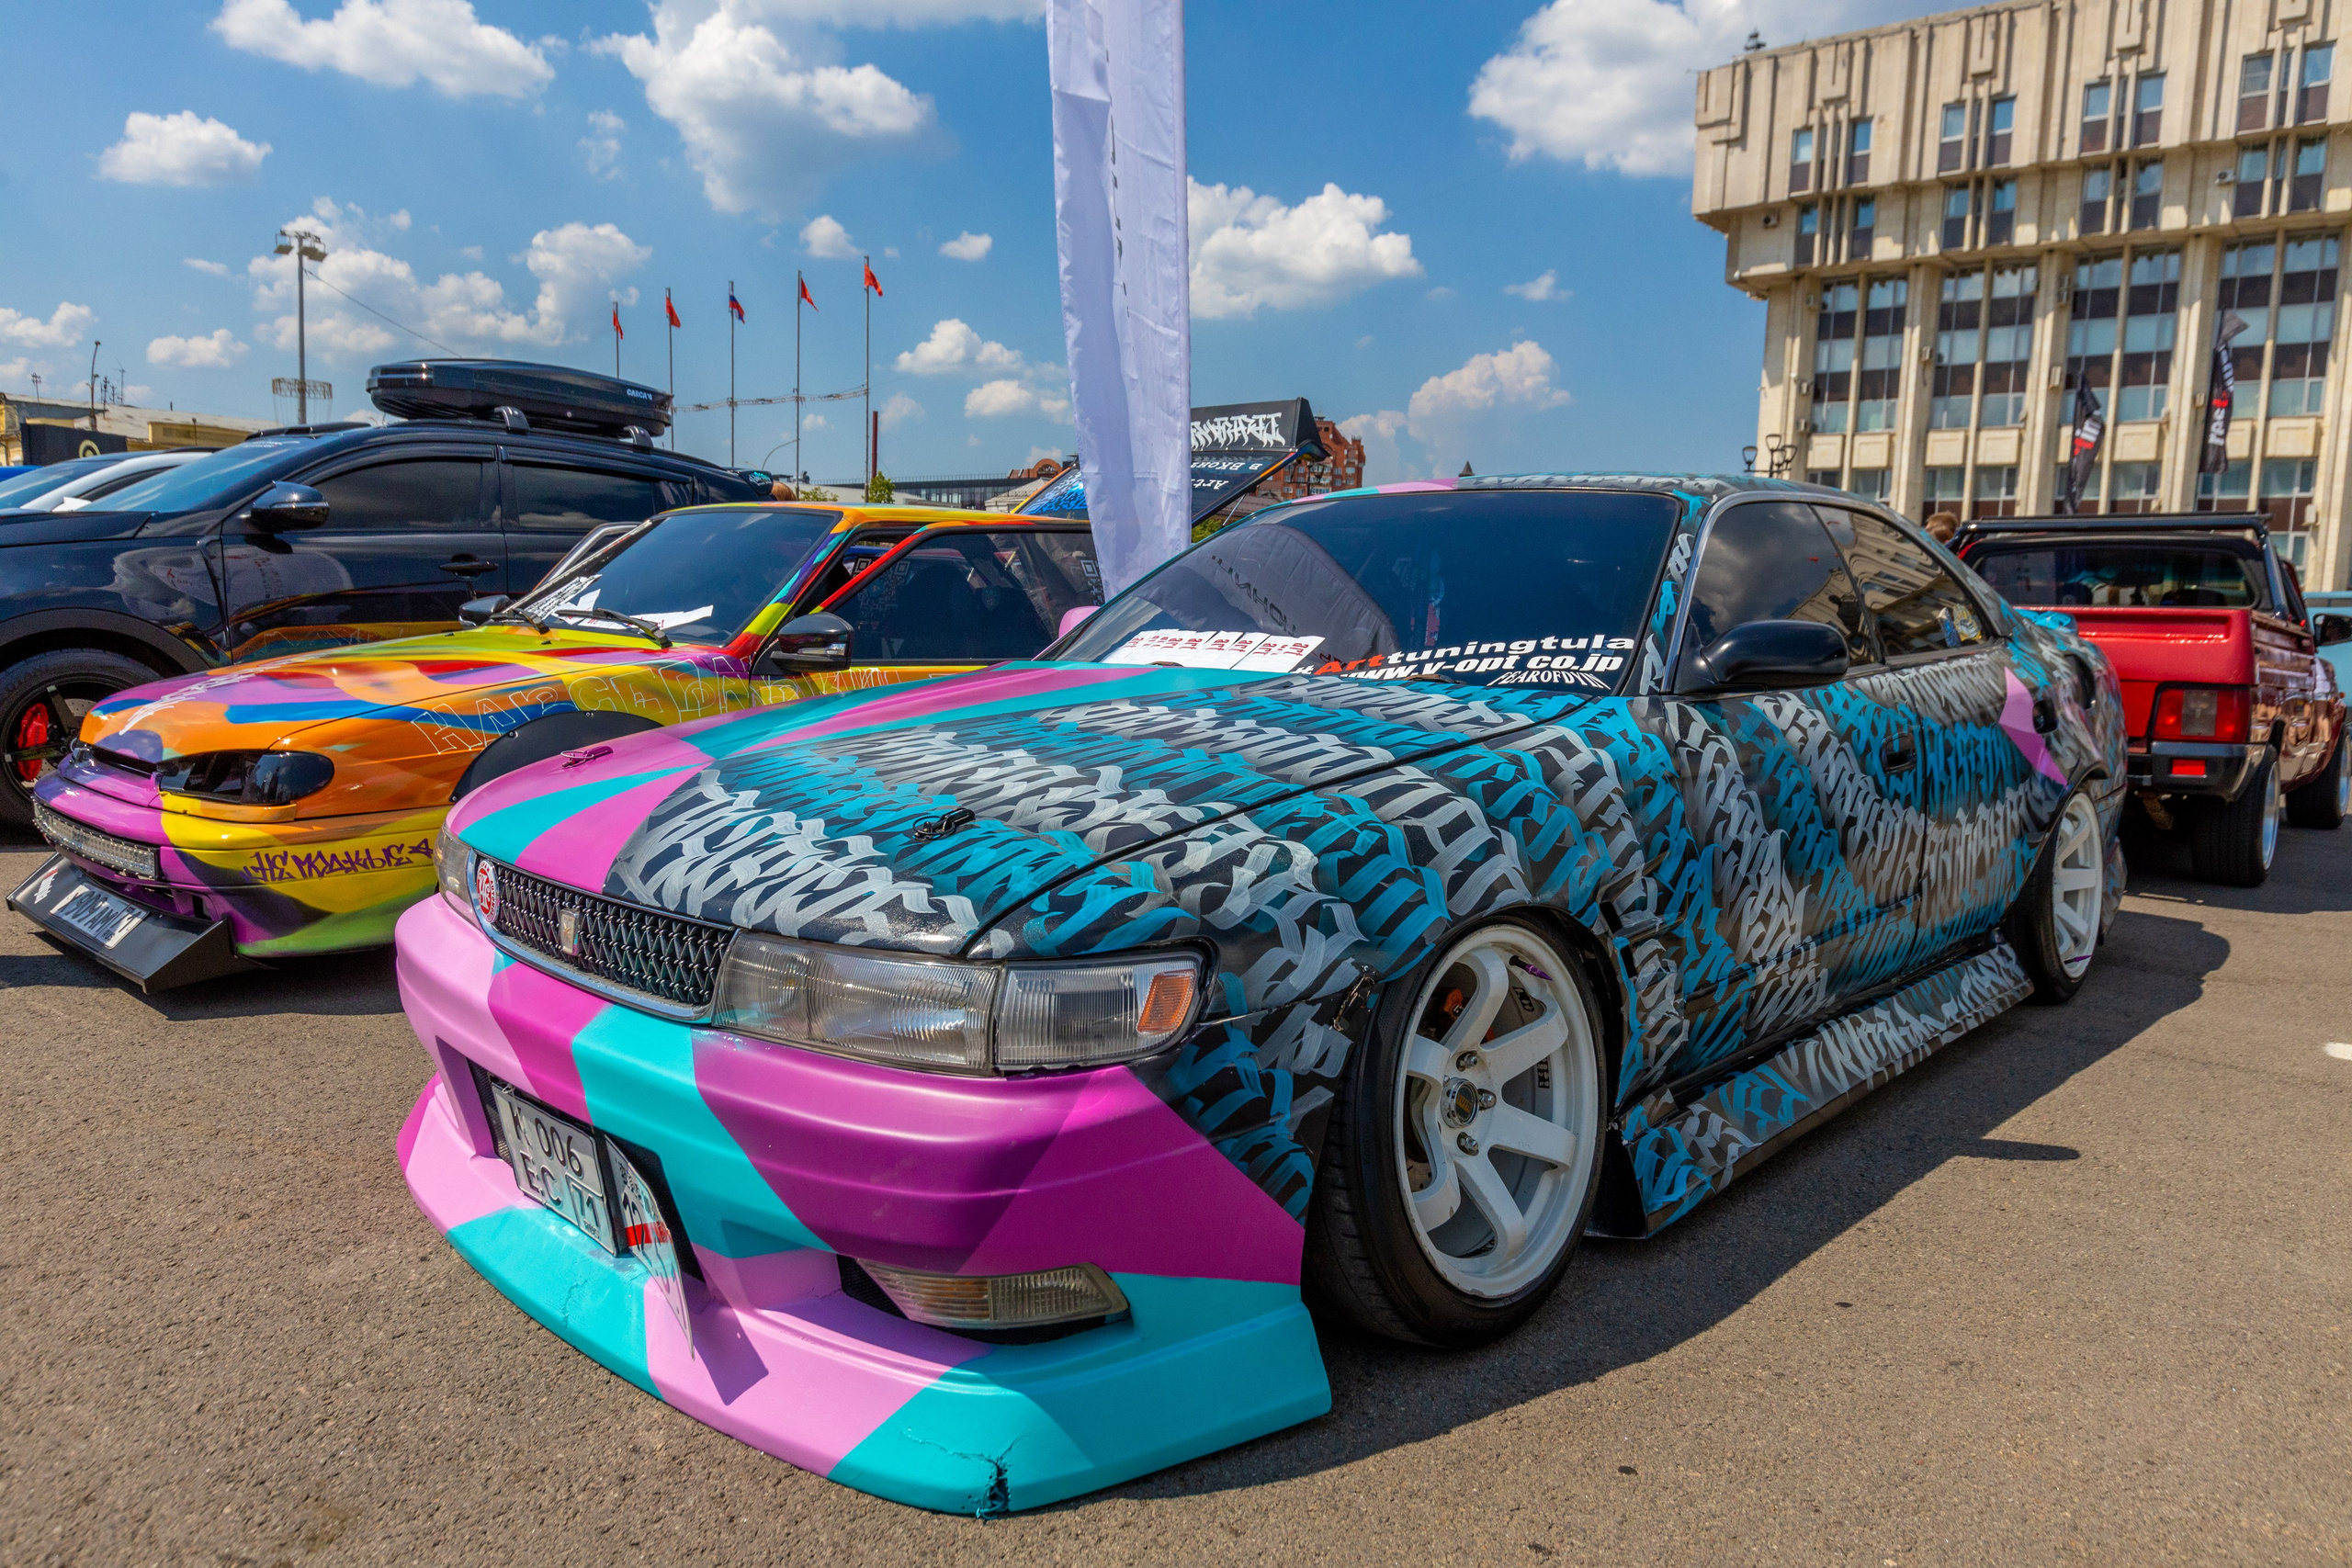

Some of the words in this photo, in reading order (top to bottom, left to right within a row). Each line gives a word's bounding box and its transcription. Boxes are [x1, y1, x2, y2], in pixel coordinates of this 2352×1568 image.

[1191, 479, 1229, 491] Art
[1205, 638, 1229, 651] art
[1228, 639, 1253, 652] art
[1283, 642, 1309, 656] art
[1527, 653, 1623, 672] co.jp
[535, 1117, 583, 1178] 006
[570, 1182, 600, 1228] 71
